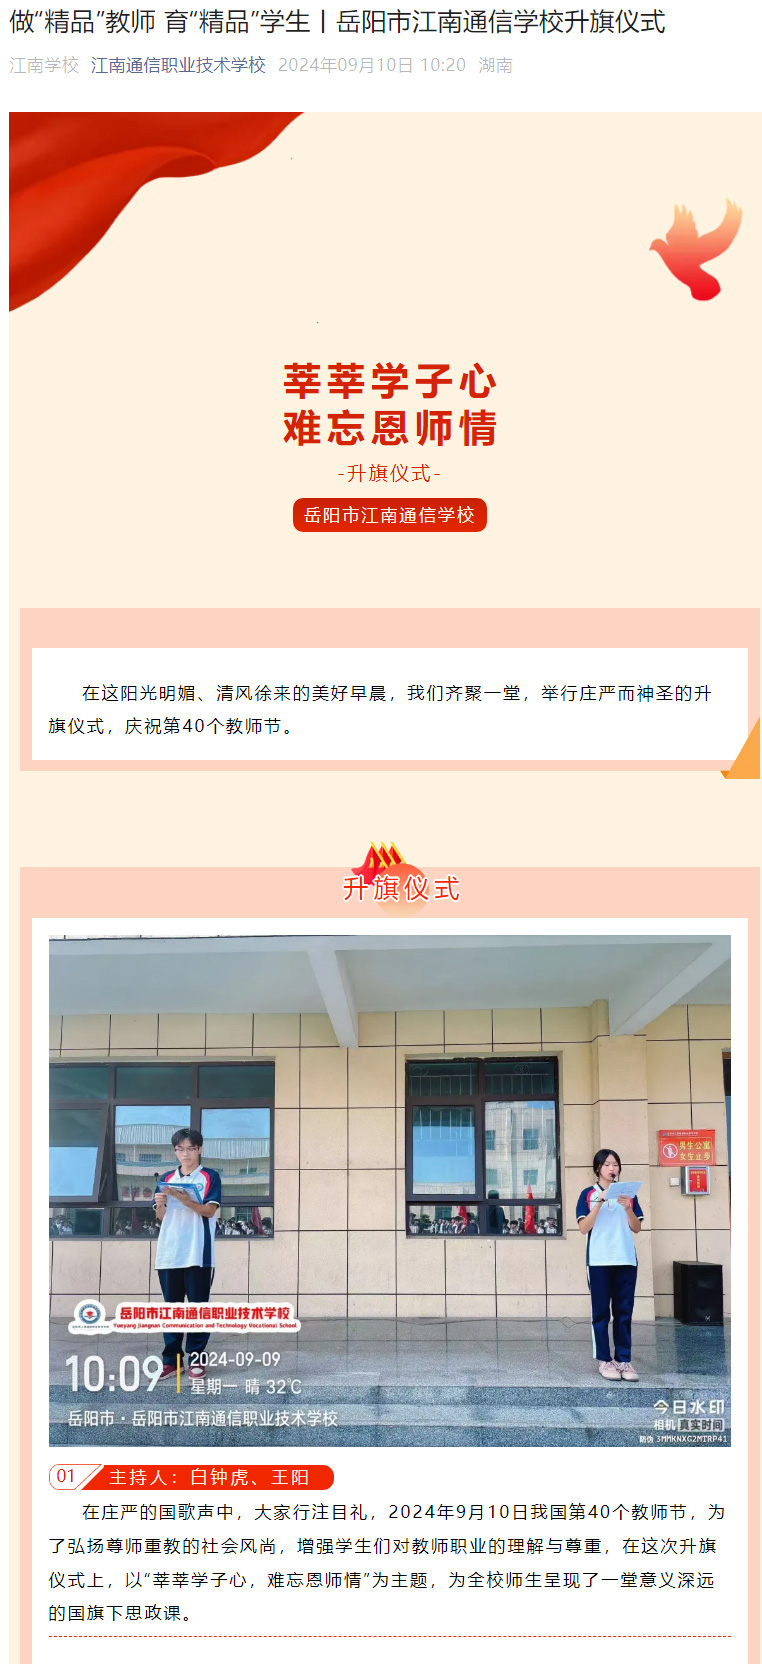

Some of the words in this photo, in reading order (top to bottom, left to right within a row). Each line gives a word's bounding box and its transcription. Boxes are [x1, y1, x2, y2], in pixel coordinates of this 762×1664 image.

[10, 56, 78, 73] 江南学校
[91, 56, 265, 73] 江南通信职业技术学校
[279, 57, 411, 73] 2024年09月10日
[422, 58, 465, 71] 10:20
[479, 57, 512, 73] 湖南
[284, 362, 496, 399] 莘莘学子心
[283, 409, 496, 446] 难忘恩师情
[304, 506, 474, 523] 岳阳市江南通信学校
[343, 874, 461, 902] 升旗仪式
[679, 1141, 710, 1150] 男生公寓
[679, 1152, 711, 1160] 女生止步
[57, 1469, 73, 1482] 01
[49, 1604, 188, 1621] 的国旗下思政课。
